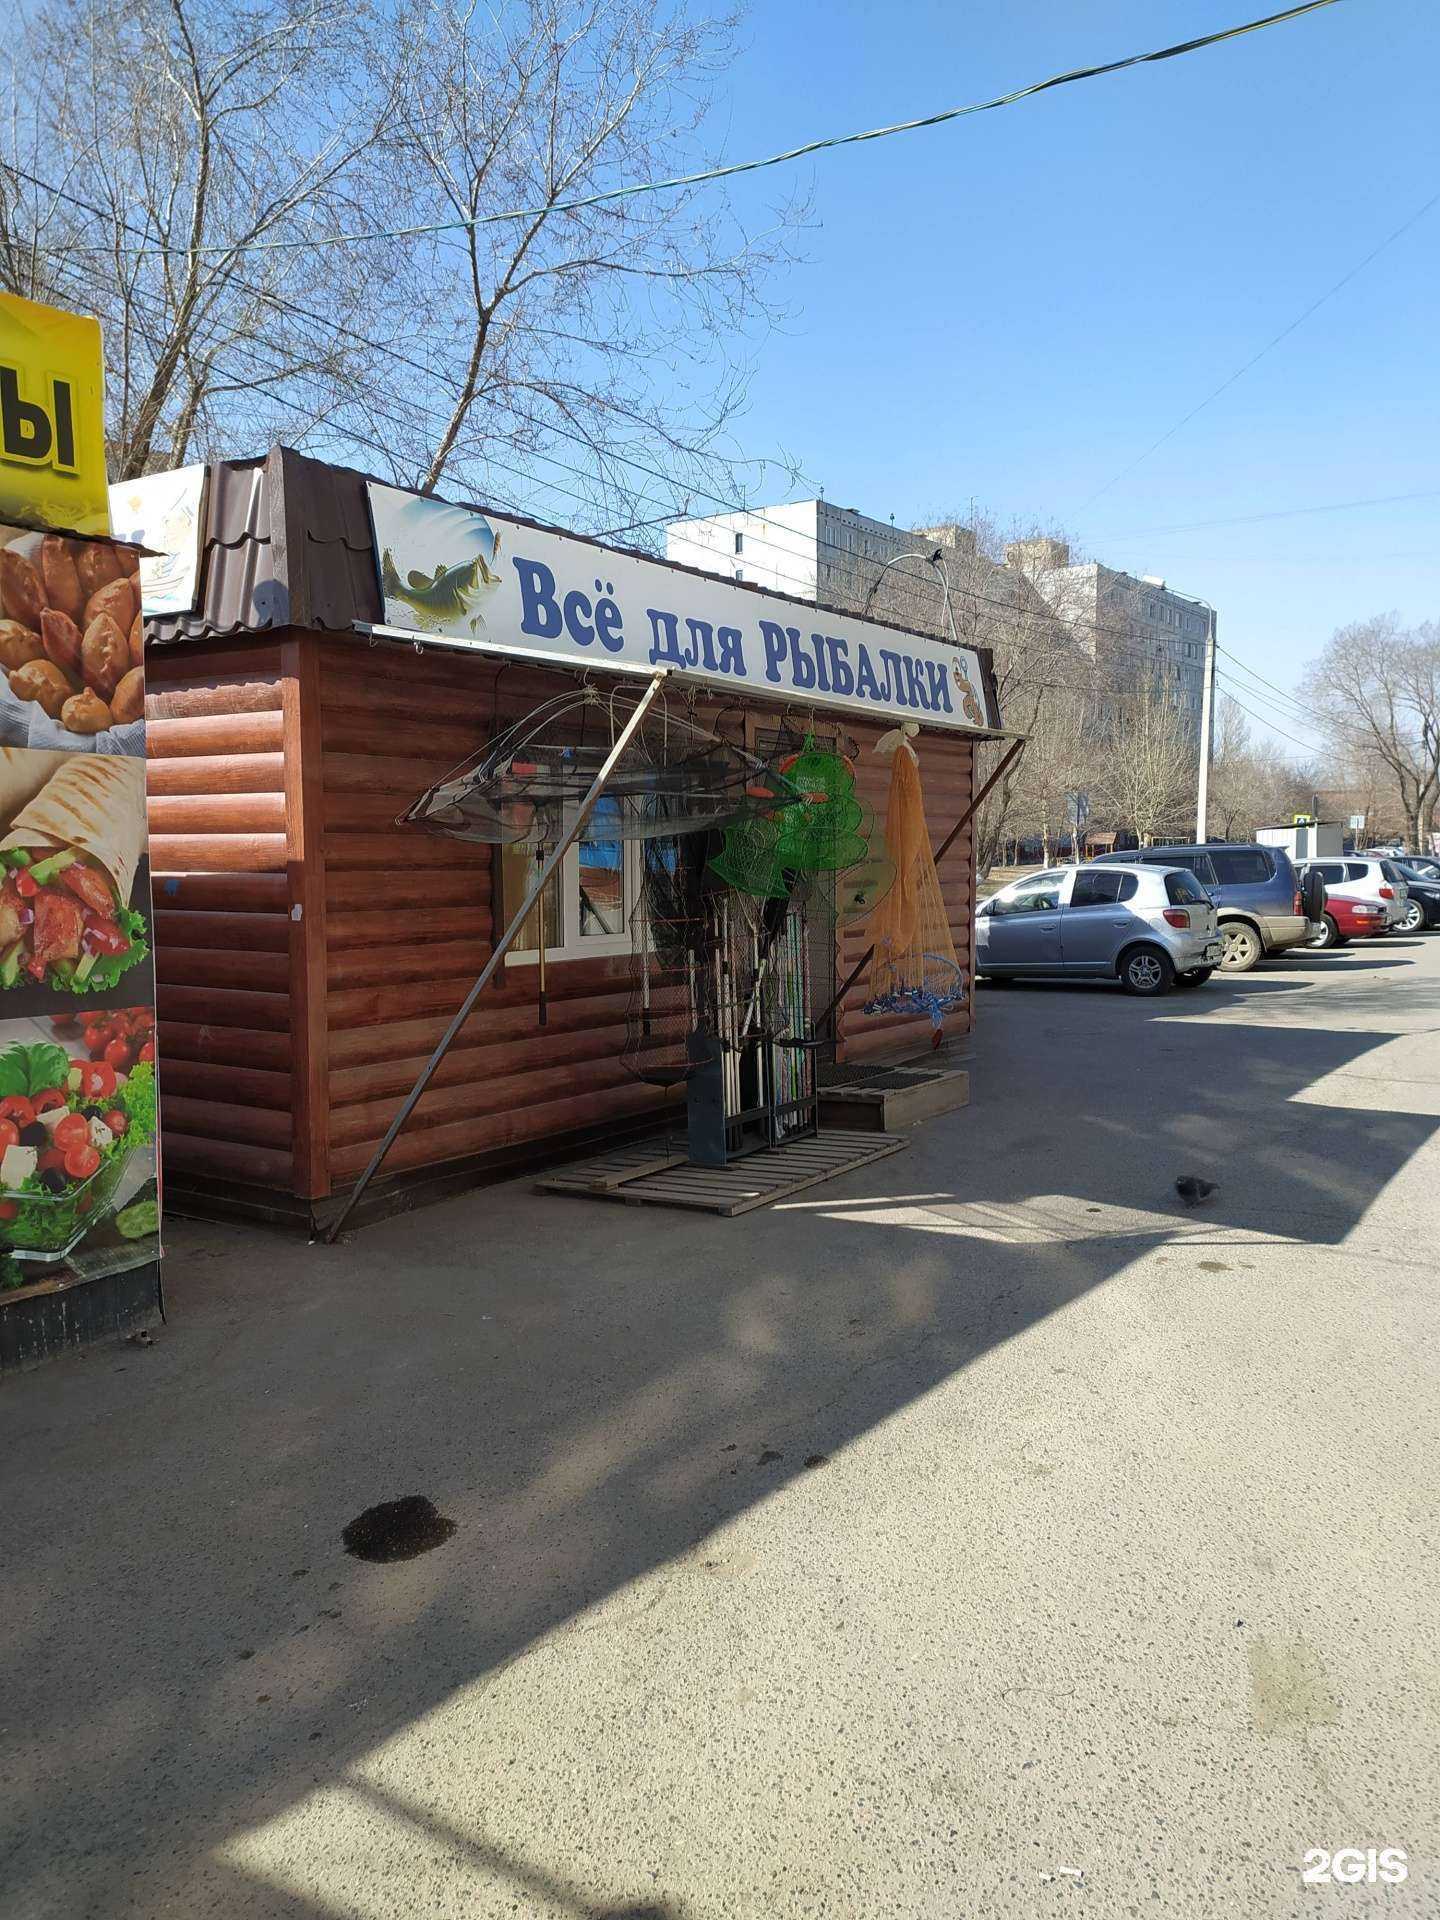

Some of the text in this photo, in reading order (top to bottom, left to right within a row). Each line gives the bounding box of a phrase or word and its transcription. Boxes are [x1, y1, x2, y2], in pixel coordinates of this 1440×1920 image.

[512, 556, 954, 713] Всё для РЫБАЛКИ
